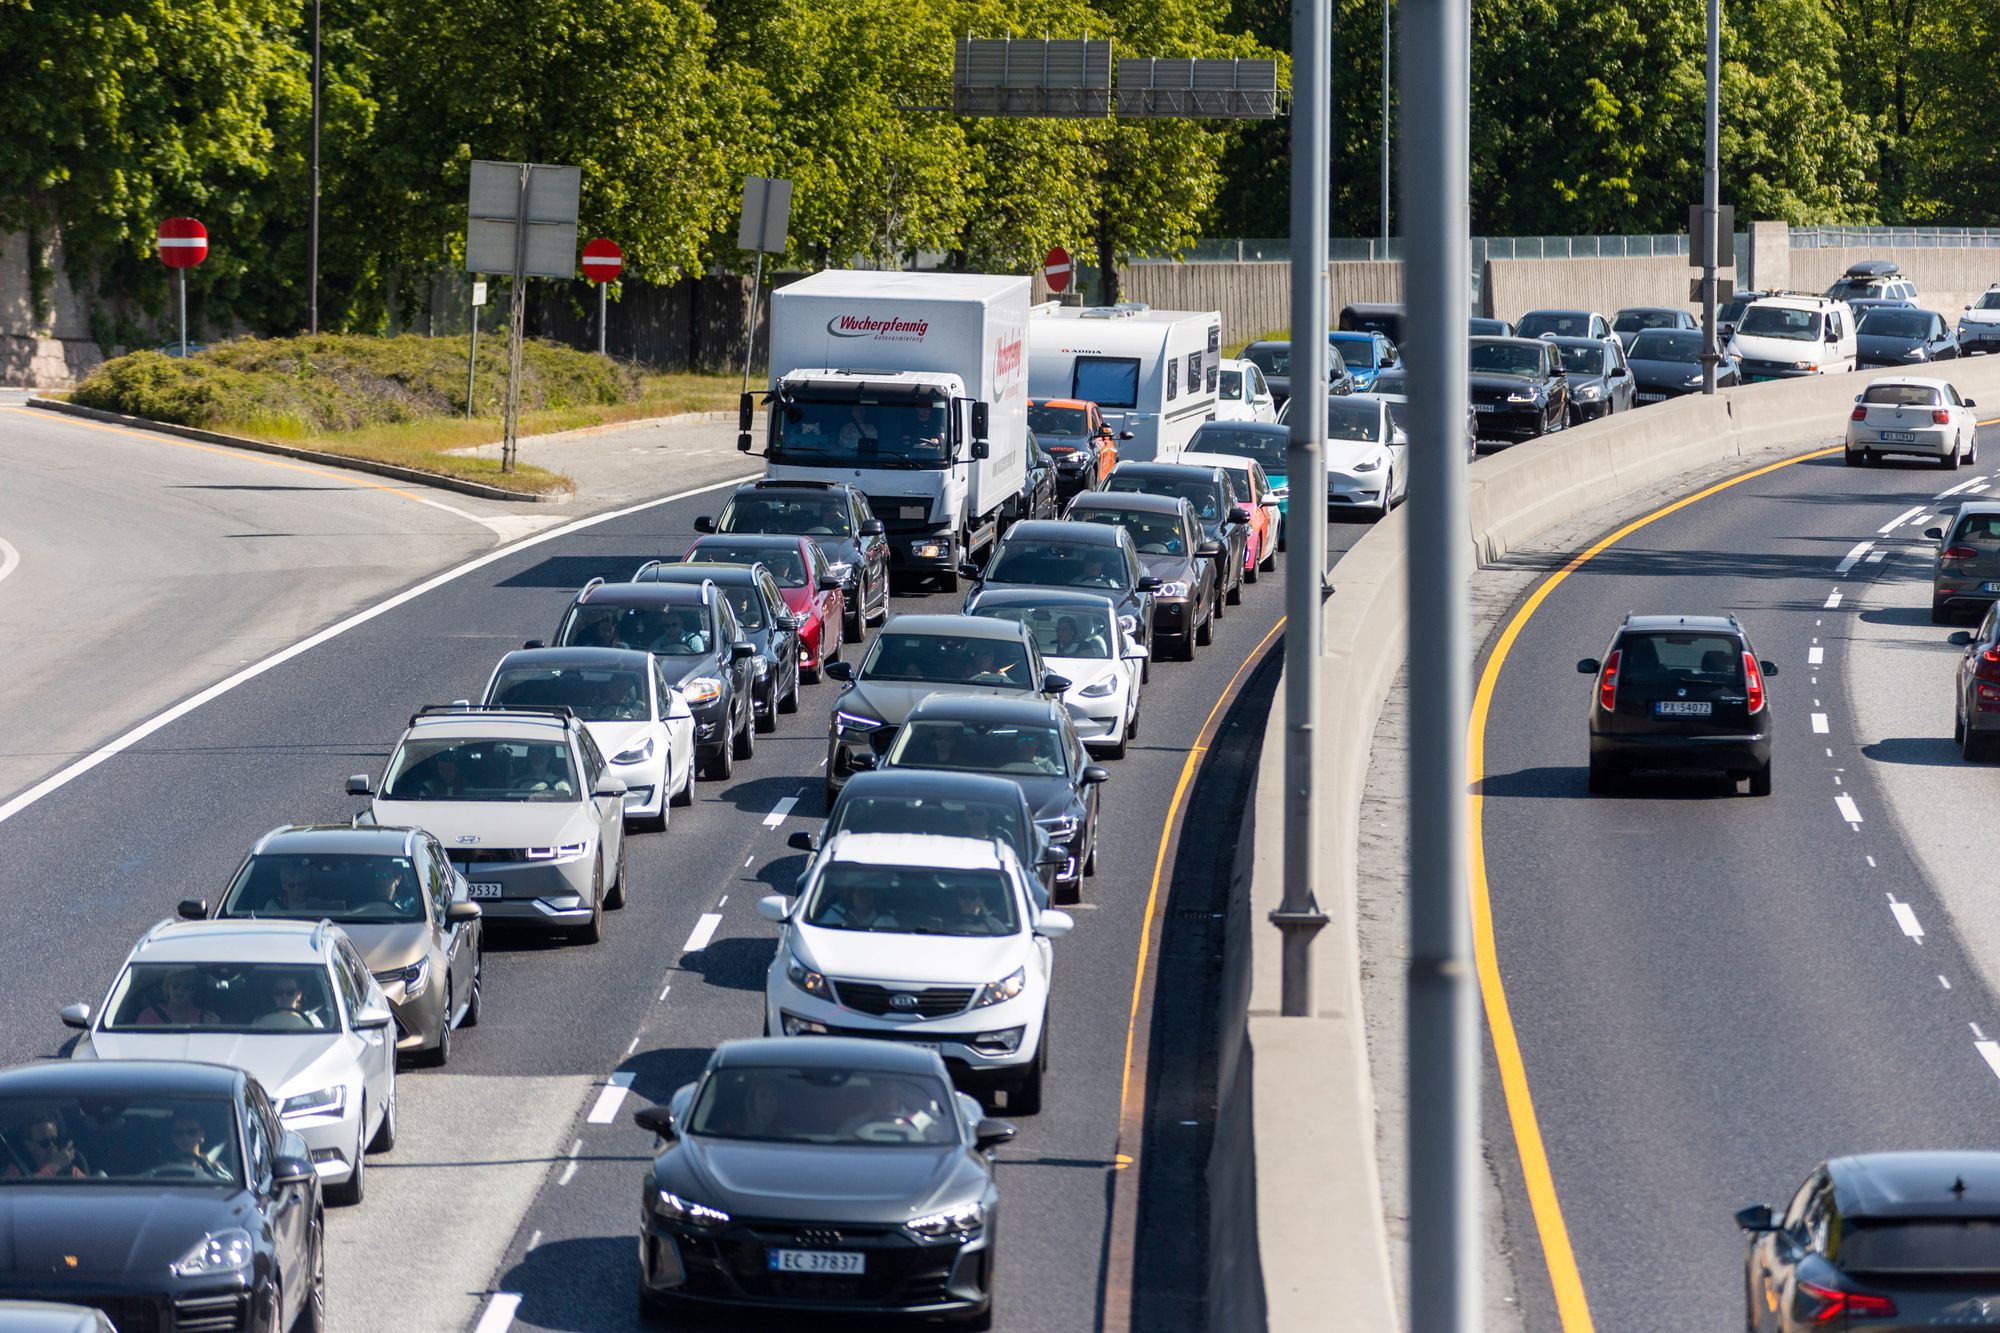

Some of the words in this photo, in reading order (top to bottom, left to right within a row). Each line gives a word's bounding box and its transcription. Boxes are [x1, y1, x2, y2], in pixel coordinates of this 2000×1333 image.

[840, 316, 929, 336] Wucherpfennig
[873, 335, 924, 343] Autovermietung
[1663, 702, 1676, 712] PX
[1680, 702, 1710, 713] 54072
[468, 885, 499, 897] 9532
[784, 1254, 804, 1268] EC
[811, 1255, 859, 1271] 37837
